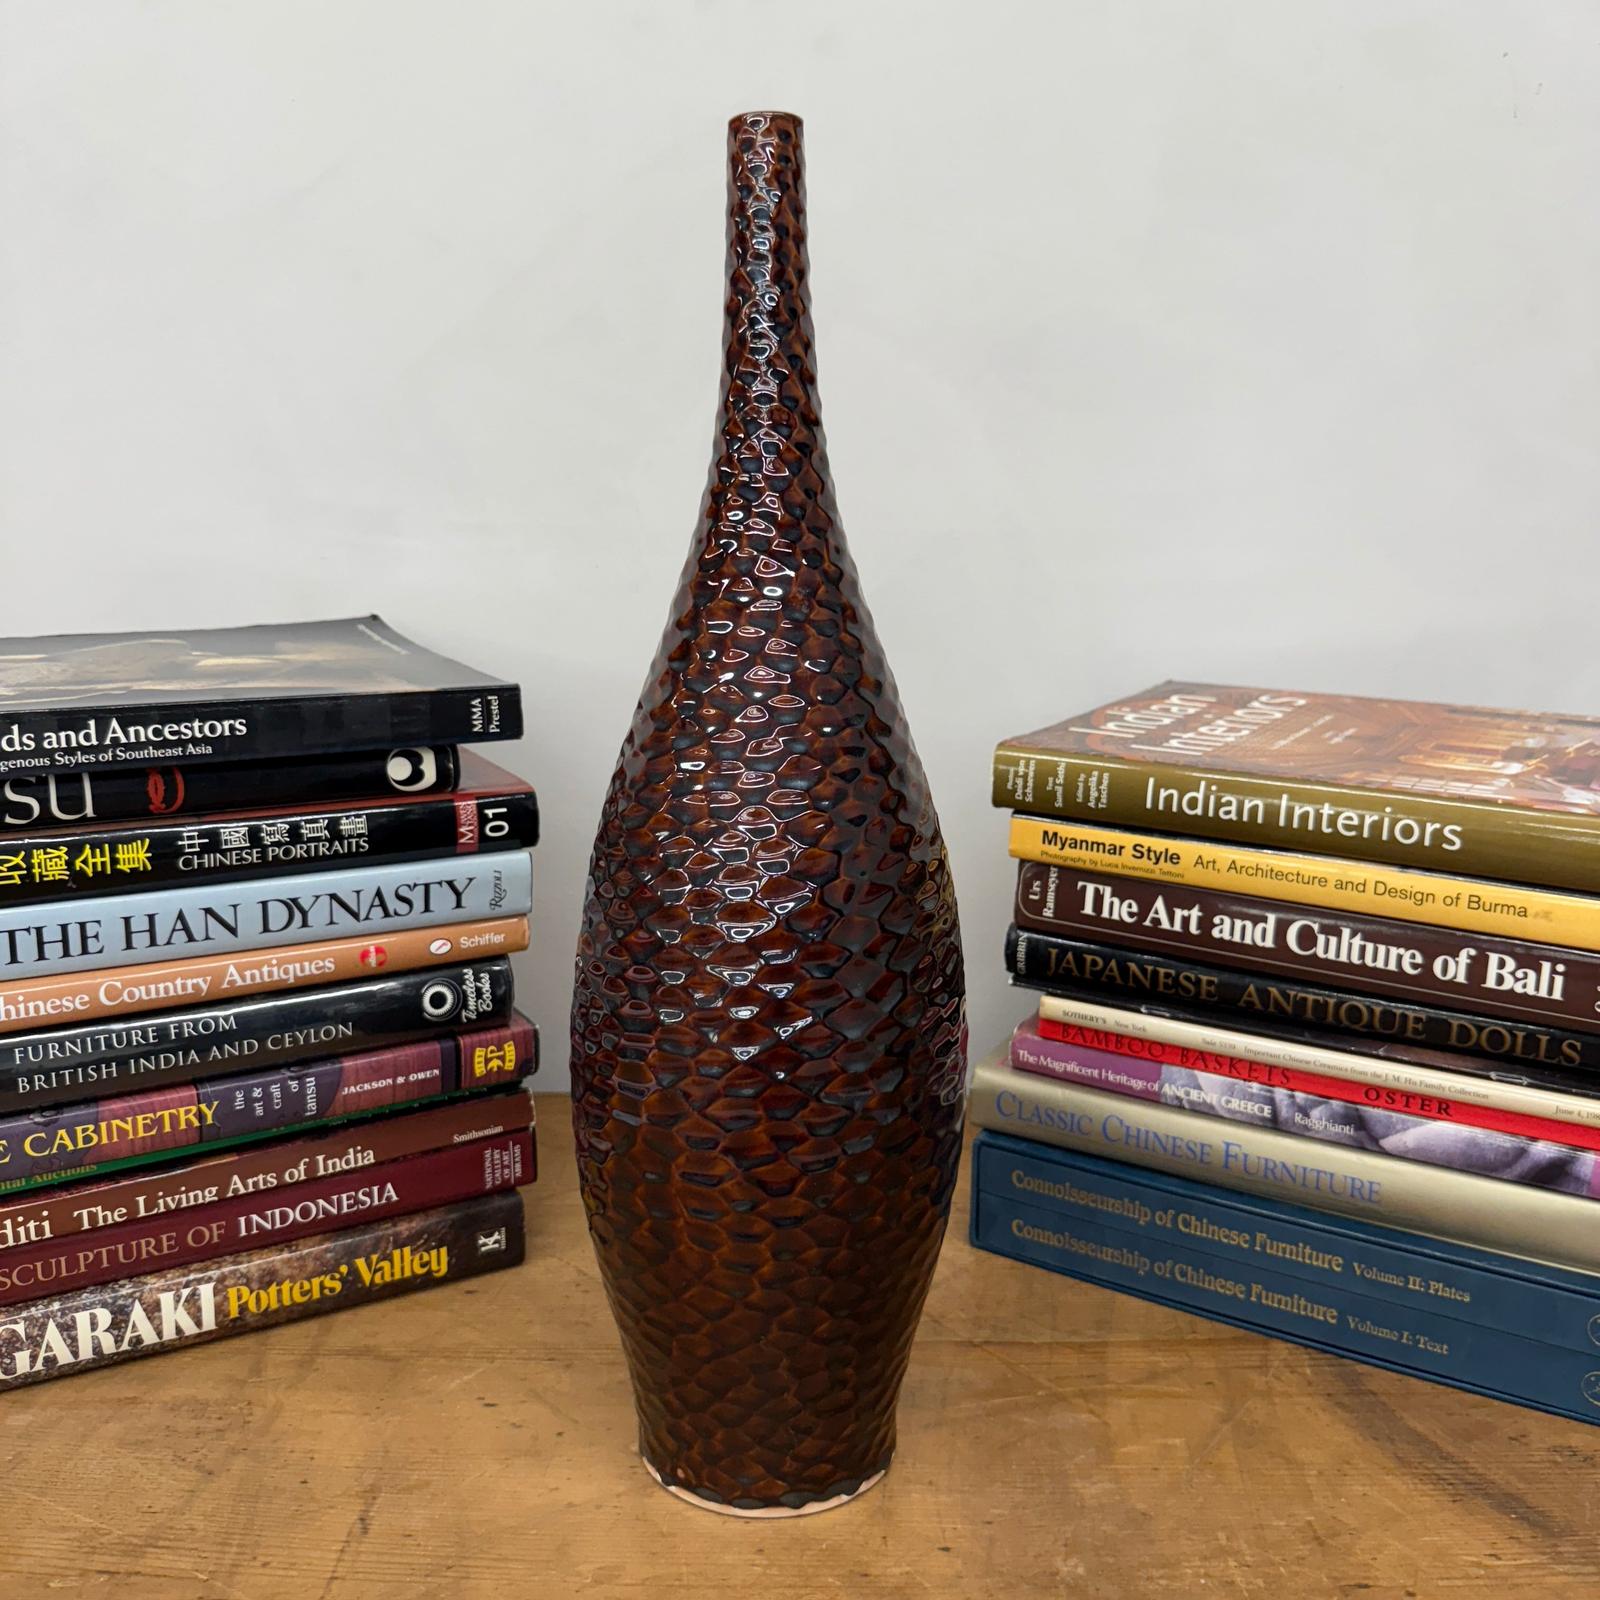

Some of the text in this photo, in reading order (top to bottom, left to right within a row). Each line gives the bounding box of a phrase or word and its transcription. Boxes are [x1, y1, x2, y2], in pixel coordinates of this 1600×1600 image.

[43, 719, 99, 749] and
[104, 717, 248, 746] Ancestors
[472, 698, 484, 732] MMA
[488, 695, 500, 733] Prestel
[55, 752, 95, 768] Styles
[99, 749, 113, 762] of
[116, 746, 184, 761] Southeast
[186, 743, 212, 755] Asia
[1088, 771, 1099, 808] Angelika
[1098, 772, 1109, 808] Taschen
[484, 806, 509, 836] 01
[1145, 777, 1463, 851] Indian Interiors
[178, 837, 369, 870] CHINESE PORTRAITS
[1042, 830, 1528, 918] Myanmar Style Art, Architecture and Design of Burma
[1028, 880, 1041, 900] Urs
[0, 877, 477, 966] THE HAN DYNASTY
[460, 933, 506, 949] Schiffer
[1077, 881, 1139, 923] The
[1142, 895, 1203, 935] Art
[1211, 912, 1276, 949] and
[1286, 919, 1424, 976] Culture
[1432, 948, 1476, 984] of
[1481, 951, 1566, 1001] Bali
[0, 957, 336, 1021] hinese Country Antiques
[462, 968, 478, 1023] Timeless
[475, 972, 493, 1013] Books
[1047, 948, 1583, 1067] JAPANESE ANTIQUE DOLLS
[14, 1015, 238, 1065] FURNITURE FROM
[17, 1022, 354, 1094] BRITISH INDIA AND CEYLON
[342, 1069, 440, 1095] JACKSON & OWEN
[1018, 1050, 1273, 1118] The Magnificent Heritage of ANCIENT GREECE
[1060, 1024, 1453, 1117] BAMBOO BASKETS OSTER
[1282, 1053, 1312, 1065] Chinese
[1313, 1060, 1348, 1073] Ceramics
[1350, 1067, 1369, 1077] from
[1418, 1080, 1446, 1093] Family
[1448, 1085, 1489, 1099] Collection
[235, 1090, 245, 1110] the
[253, 1102, 264, 1116] art
[270, 1082, 282, 1109] craft
[305, 1077, 316, 1116] tansu
[24, 1101, 219, 1157] CABINETRY
[453, 1125, 504, 1143] Smithsonian
[1294, 1112, 1355, 1135] Ragghianti
[995, 1090, 1383, 1204] CLASSIC CHINESE FURNITURE
[73, 1206, 129, 1231] The
[136, 1185, 219, 1218] Living
[226, 1174, 277, 1197] Arts
[284, 1158, 309, 1183] of
[316, 1146, 376, 1177] India
[0, 1182, 400, 1291] SCULPTURE OF INDONESIA
[1011, 1169, 1471, 1303] Connoisseurship of Chinese Furniture Volume II: Plates
[1011, 1219, 1449, 1356] Connoisseurship of Chinese Furniture Volume I: Text
[0, 1245, 448, 1381] GARAKI Potters’ Valley
